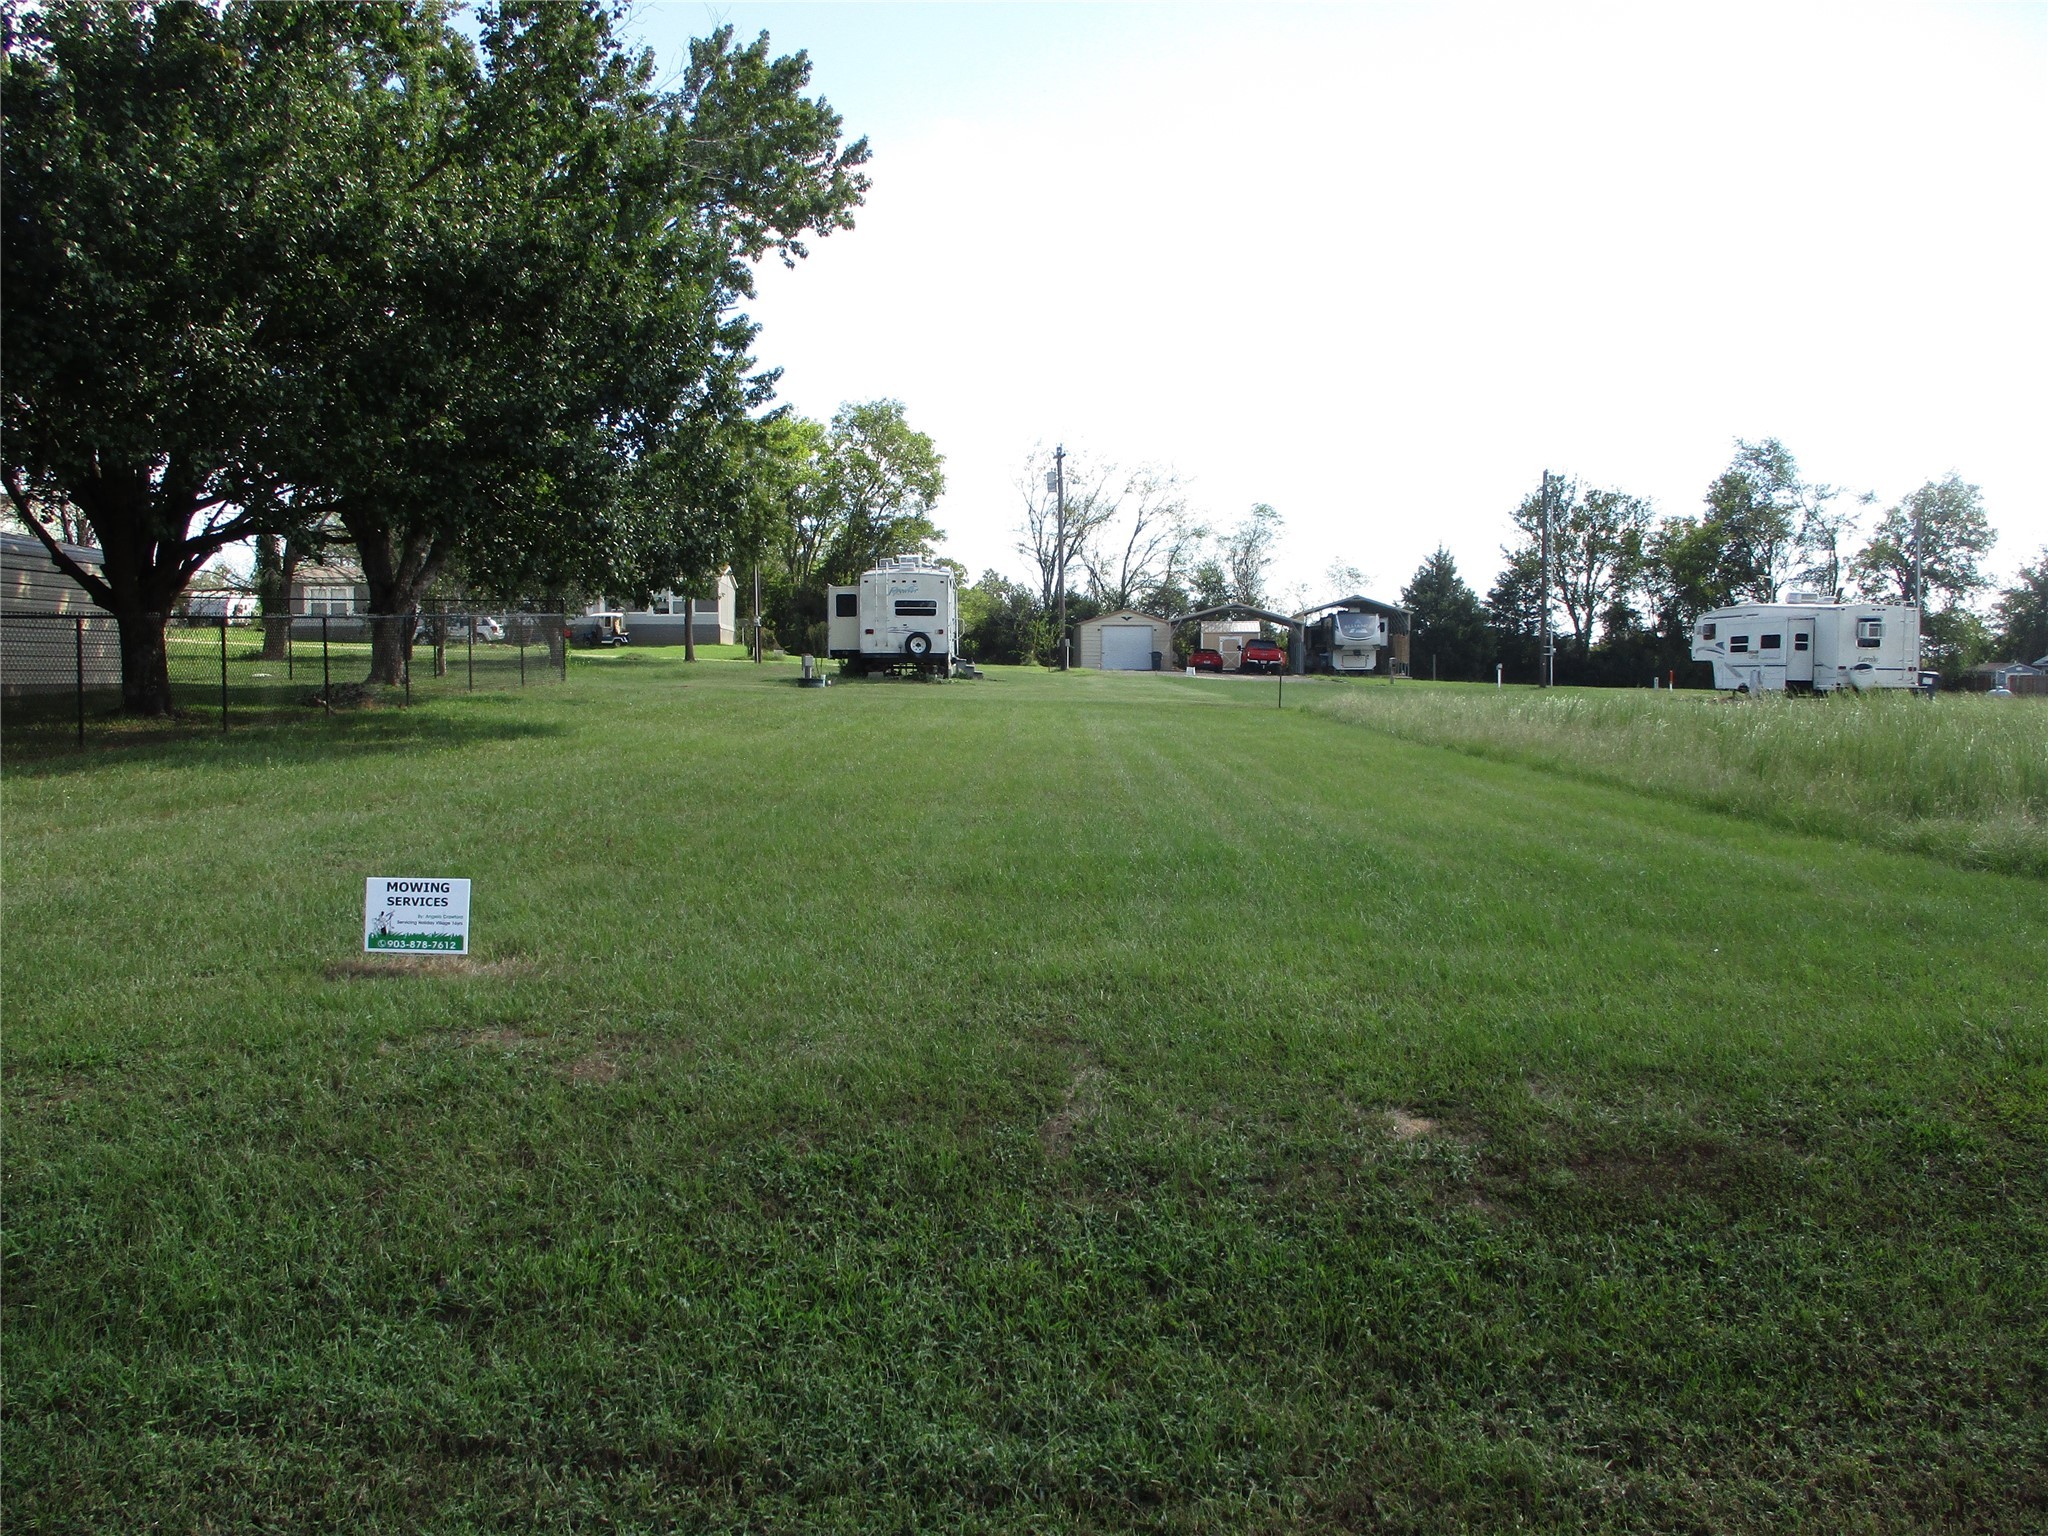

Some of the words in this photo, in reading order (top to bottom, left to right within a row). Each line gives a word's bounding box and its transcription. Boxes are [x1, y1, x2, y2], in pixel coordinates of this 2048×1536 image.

[387, 881, 450, 893] MOWING
[387, 896, 449, 907] SERVICES
[387, 940, 456, 949] 903-878-7612
